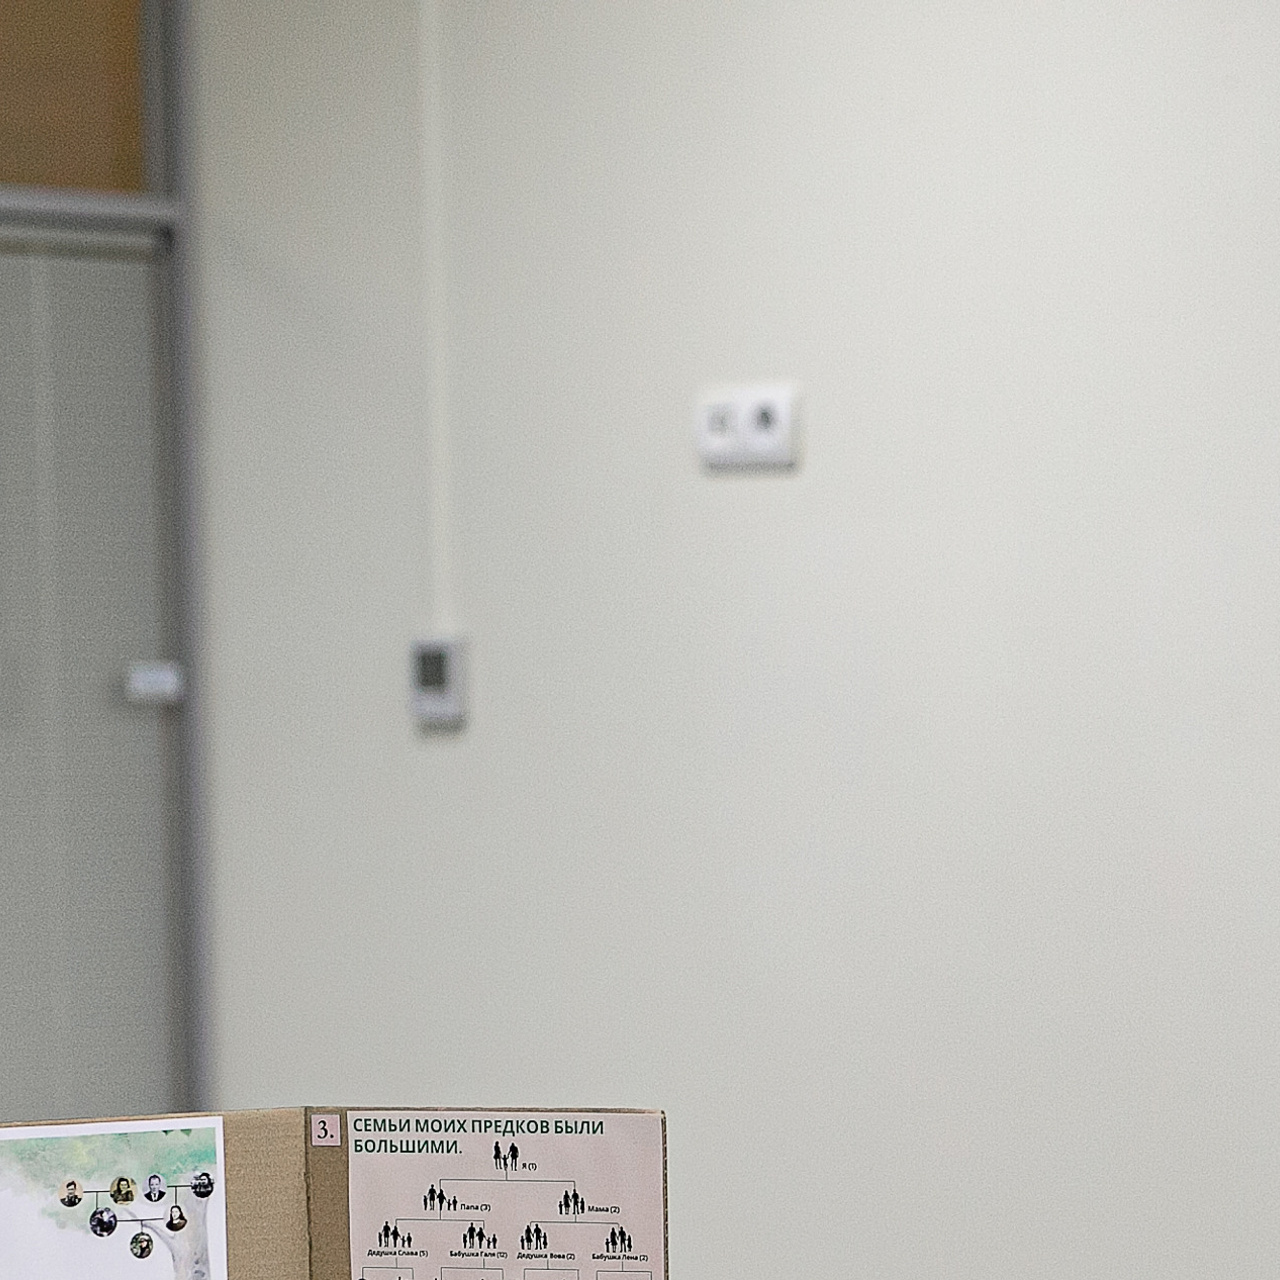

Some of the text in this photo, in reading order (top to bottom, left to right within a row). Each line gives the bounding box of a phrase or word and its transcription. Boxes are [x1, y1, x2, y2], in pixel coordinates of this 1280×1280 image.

[317, 1119, 335, 1140] 3.
[353, 1118, 604, 1136] СЕМЬИ МОИХ ПРЕДКОВ БЫЛИ
[354, 1139, 463, 1155] БОЛЬШИМИ.
[461, 1204, 479, 1212] Папа
[450, 1251, 479, 1260] Бабушка
[517, 1253, 548, 1262] Дедушка
[592, 1254, 621, 1263] Бабушка
